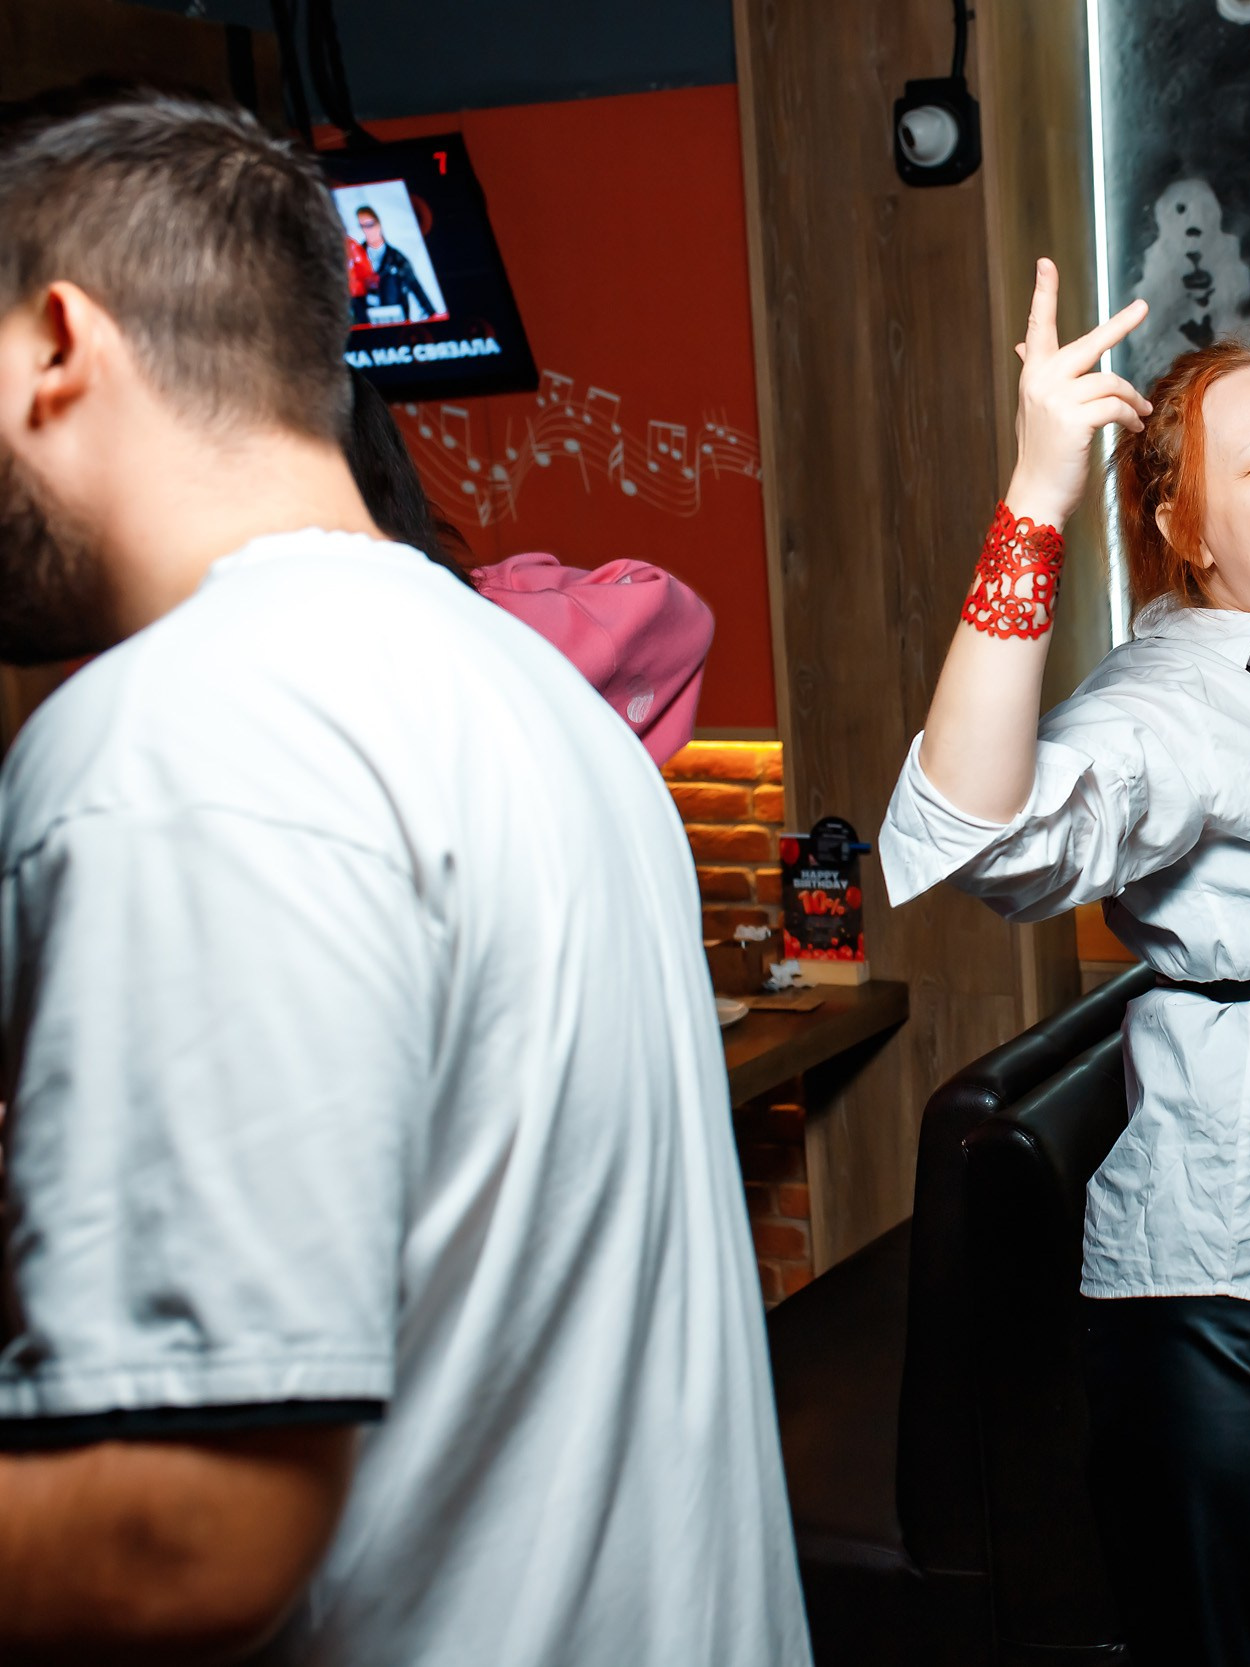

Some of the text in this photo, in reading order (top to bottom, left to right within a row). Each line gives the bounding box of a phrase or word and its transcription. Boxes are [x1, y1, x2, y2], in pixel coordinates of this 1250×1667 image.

[801, 869, 839, 880] HAPPY
[793, 878, 848, 890] BIRTHDAY
[798, 890, 846, 915] 10%
